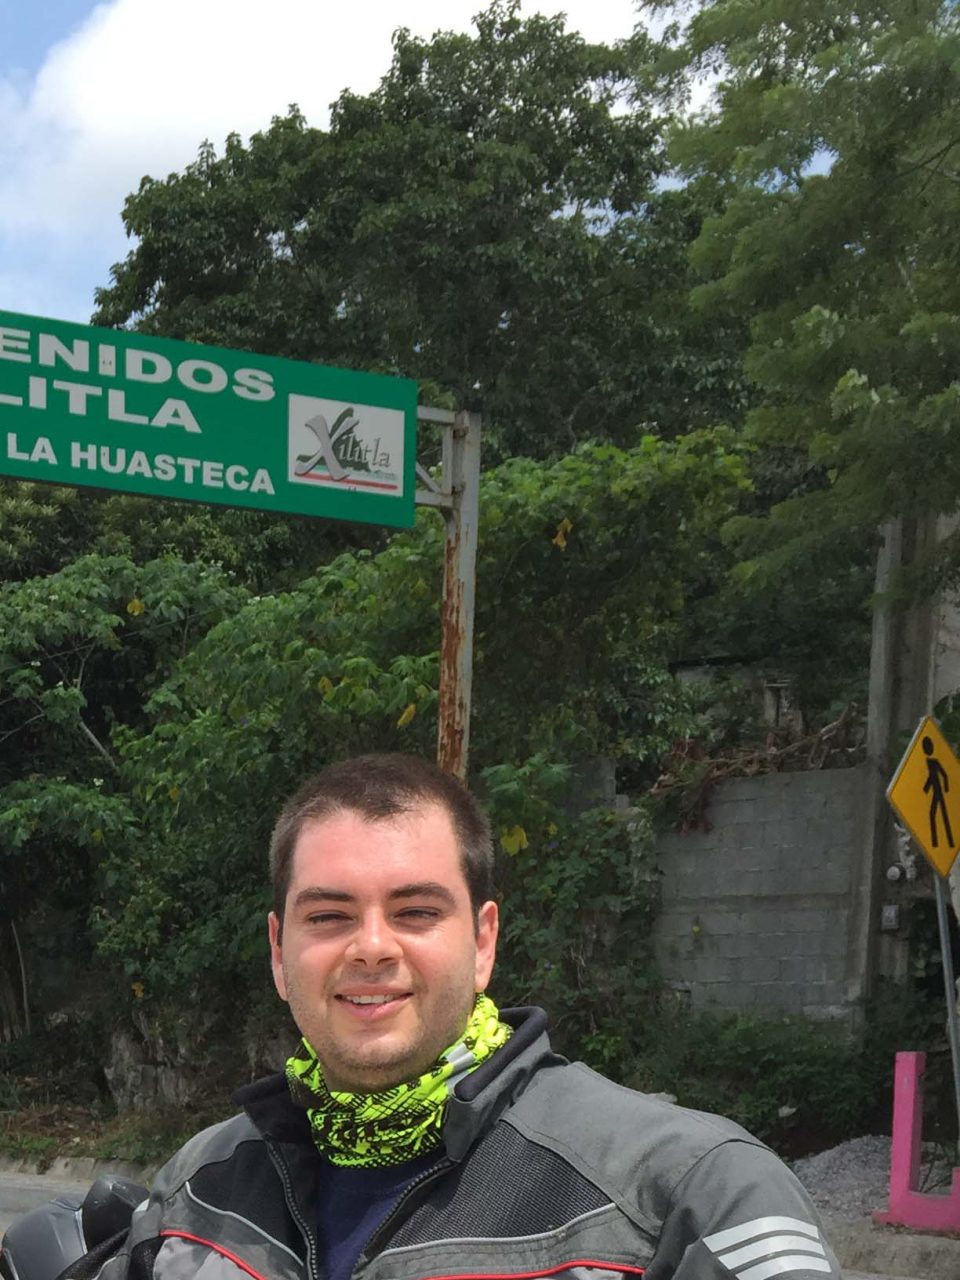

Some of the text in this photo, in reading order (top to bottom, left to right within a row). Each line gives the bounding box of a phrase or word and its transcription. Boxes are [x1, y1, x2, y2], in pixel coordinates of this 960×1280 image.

[7, 432, 57, 465] LA
[71, 442, 275, 495] HUASTECA
[294, 408, 391, 481] Xilitla
